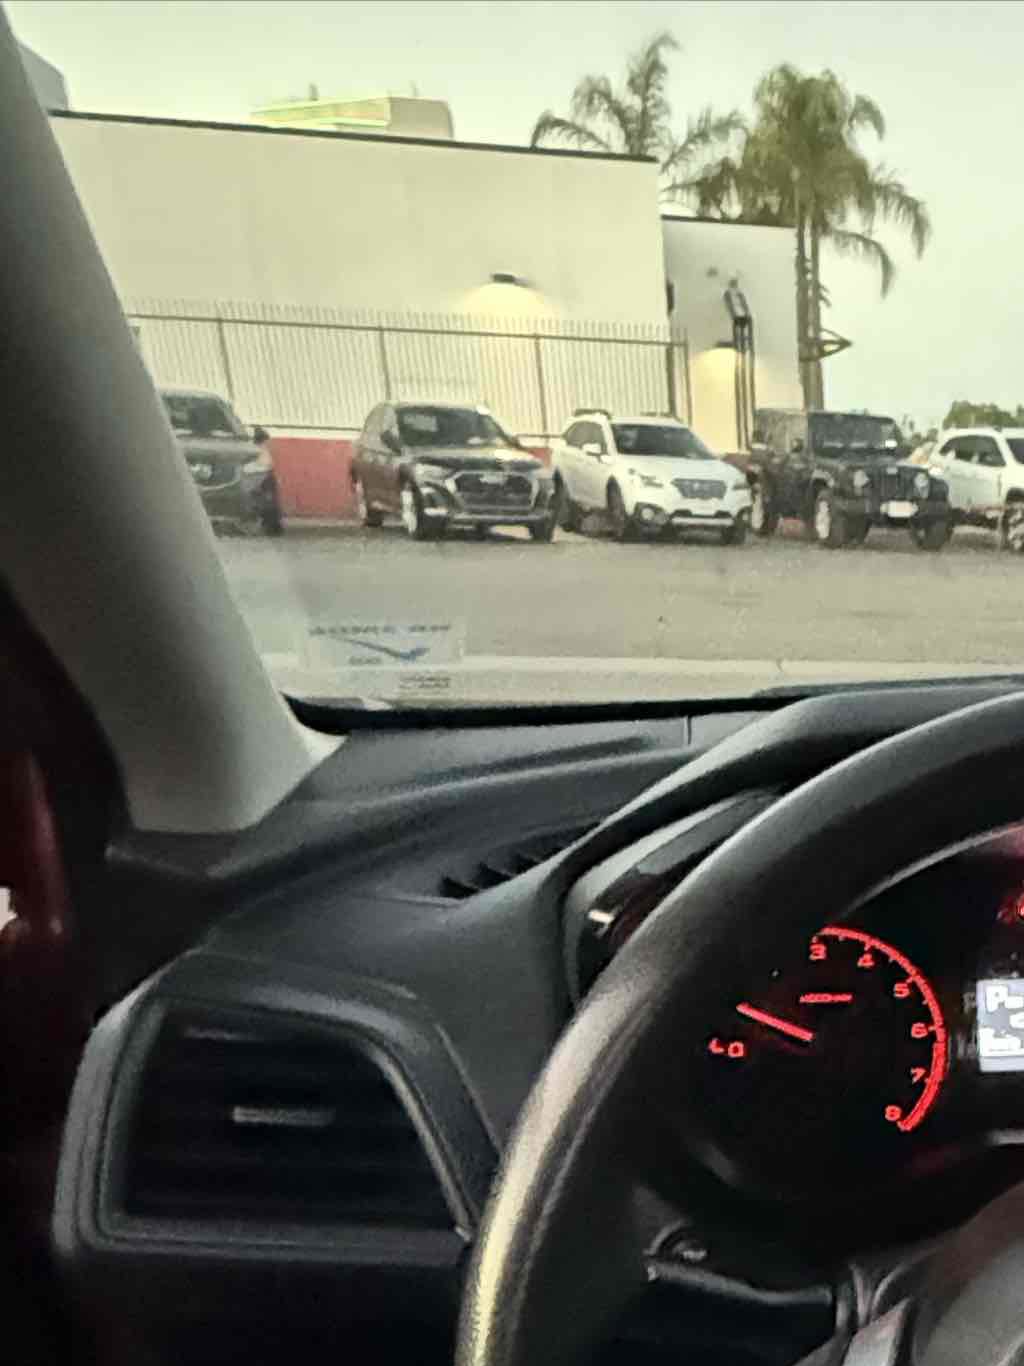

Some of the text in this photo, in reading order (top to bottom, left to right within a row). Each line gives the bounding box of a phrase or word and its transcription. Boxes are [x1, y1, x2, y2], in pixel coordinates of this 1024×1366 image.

[893, 982, 910, 998] 5
[910, 1022, 928, 1039] 6
[910, 1067, 927, 1084] 7
